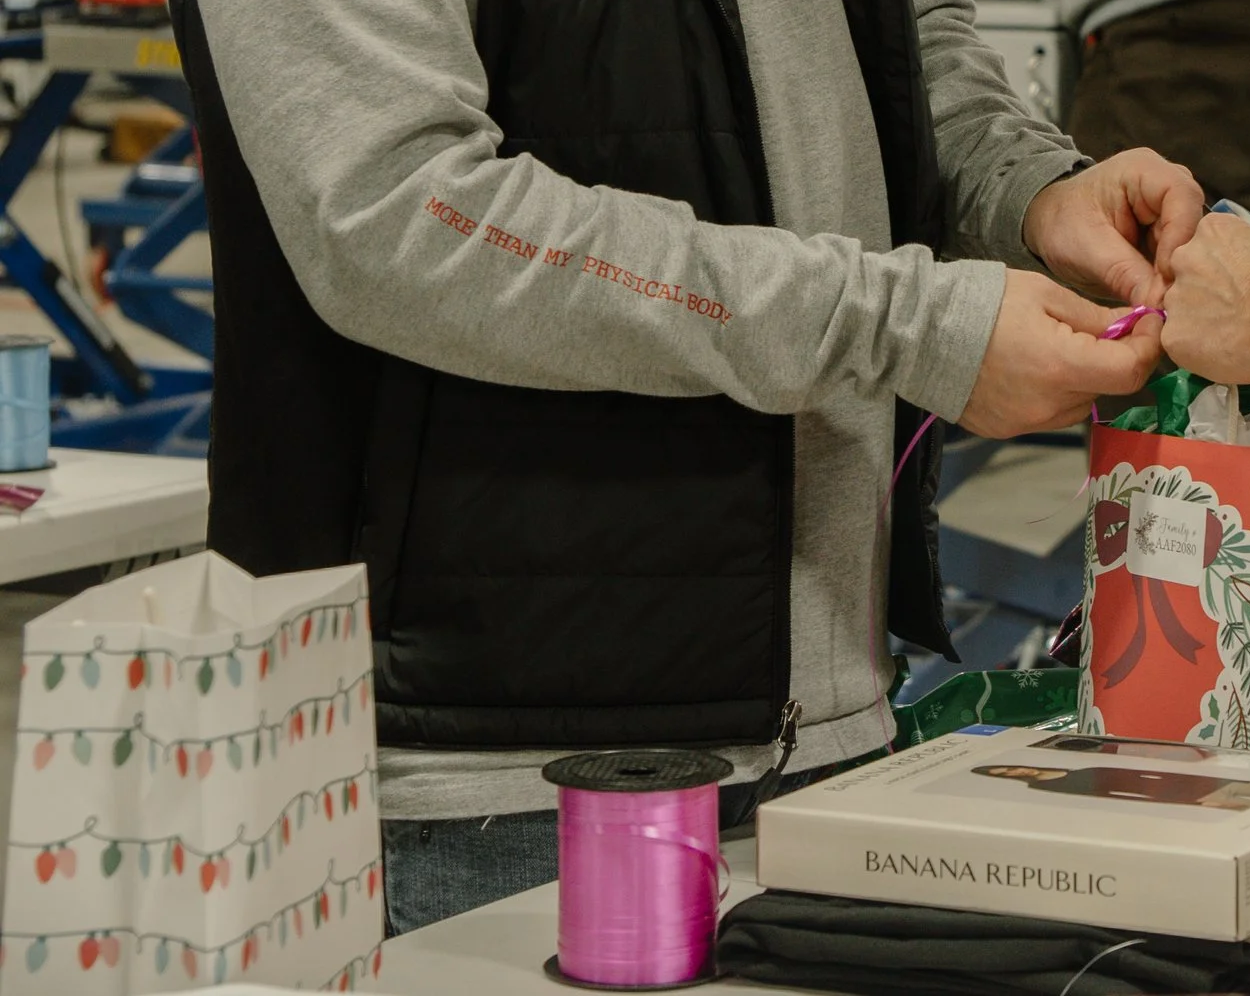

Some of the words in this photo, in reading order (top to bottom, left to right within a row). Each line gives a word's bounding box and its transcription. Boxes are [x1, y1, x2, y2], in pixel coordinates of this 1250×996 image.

[424, 196, 478, 236] MORE
[483, 223, 538, 261] THAN
[542, 247, 575, 268] MY
[580, 255, 684, 304] PHYSICAL
[686, 292, 733, 327] BODY
[1155, 538, 1197, 556] AAF2080
[865, 850, 977, 882] BANANA
[986, 863, 1118, 898] REPUBLIC
